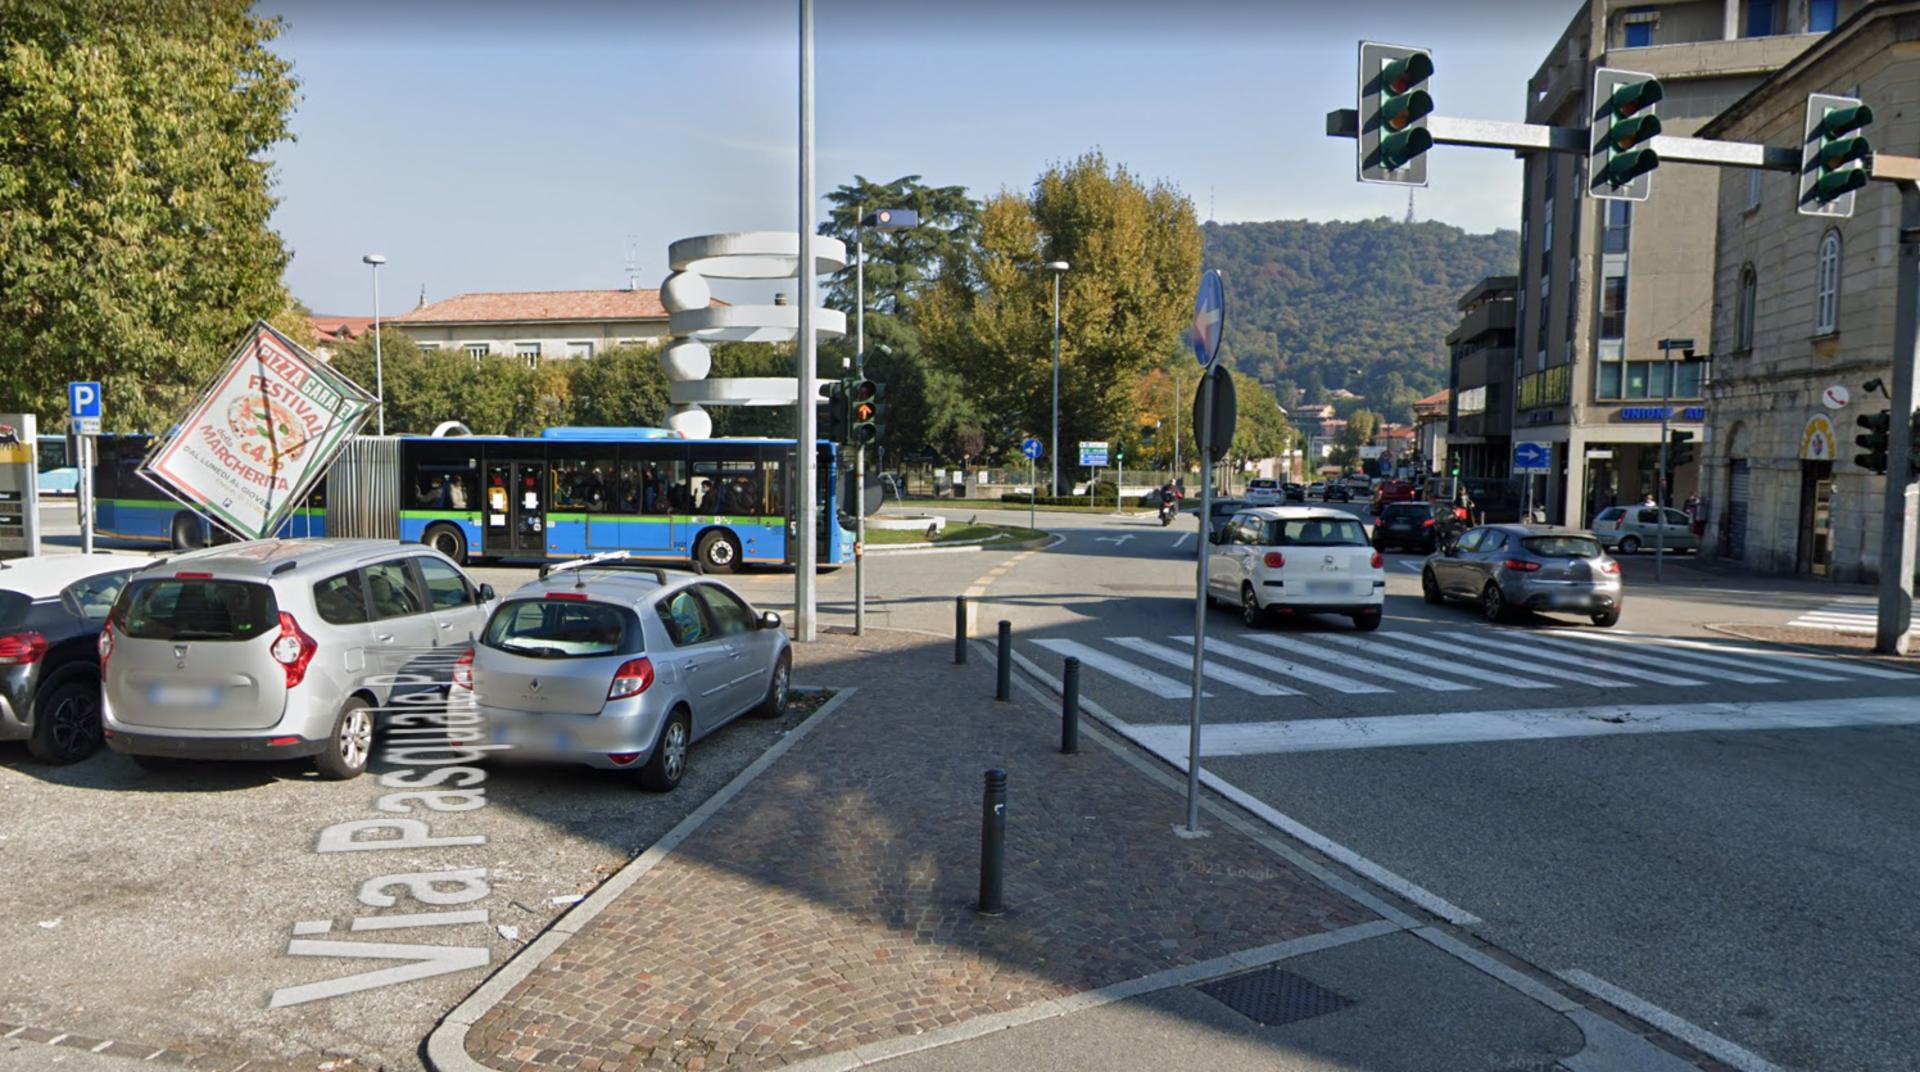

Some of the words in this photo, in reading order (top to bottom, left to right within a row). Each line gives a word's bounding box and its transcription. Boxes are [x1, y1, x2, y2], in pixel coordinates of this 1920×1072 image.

[258, 346, 306, 389] PIZZA
[74, 386, 94, 414] P
[248, 374, 323, 438] FESTIVAL
[200, 424, 289, 491] MARGHERITA
[241, 486, 272, 511] GIOVE
